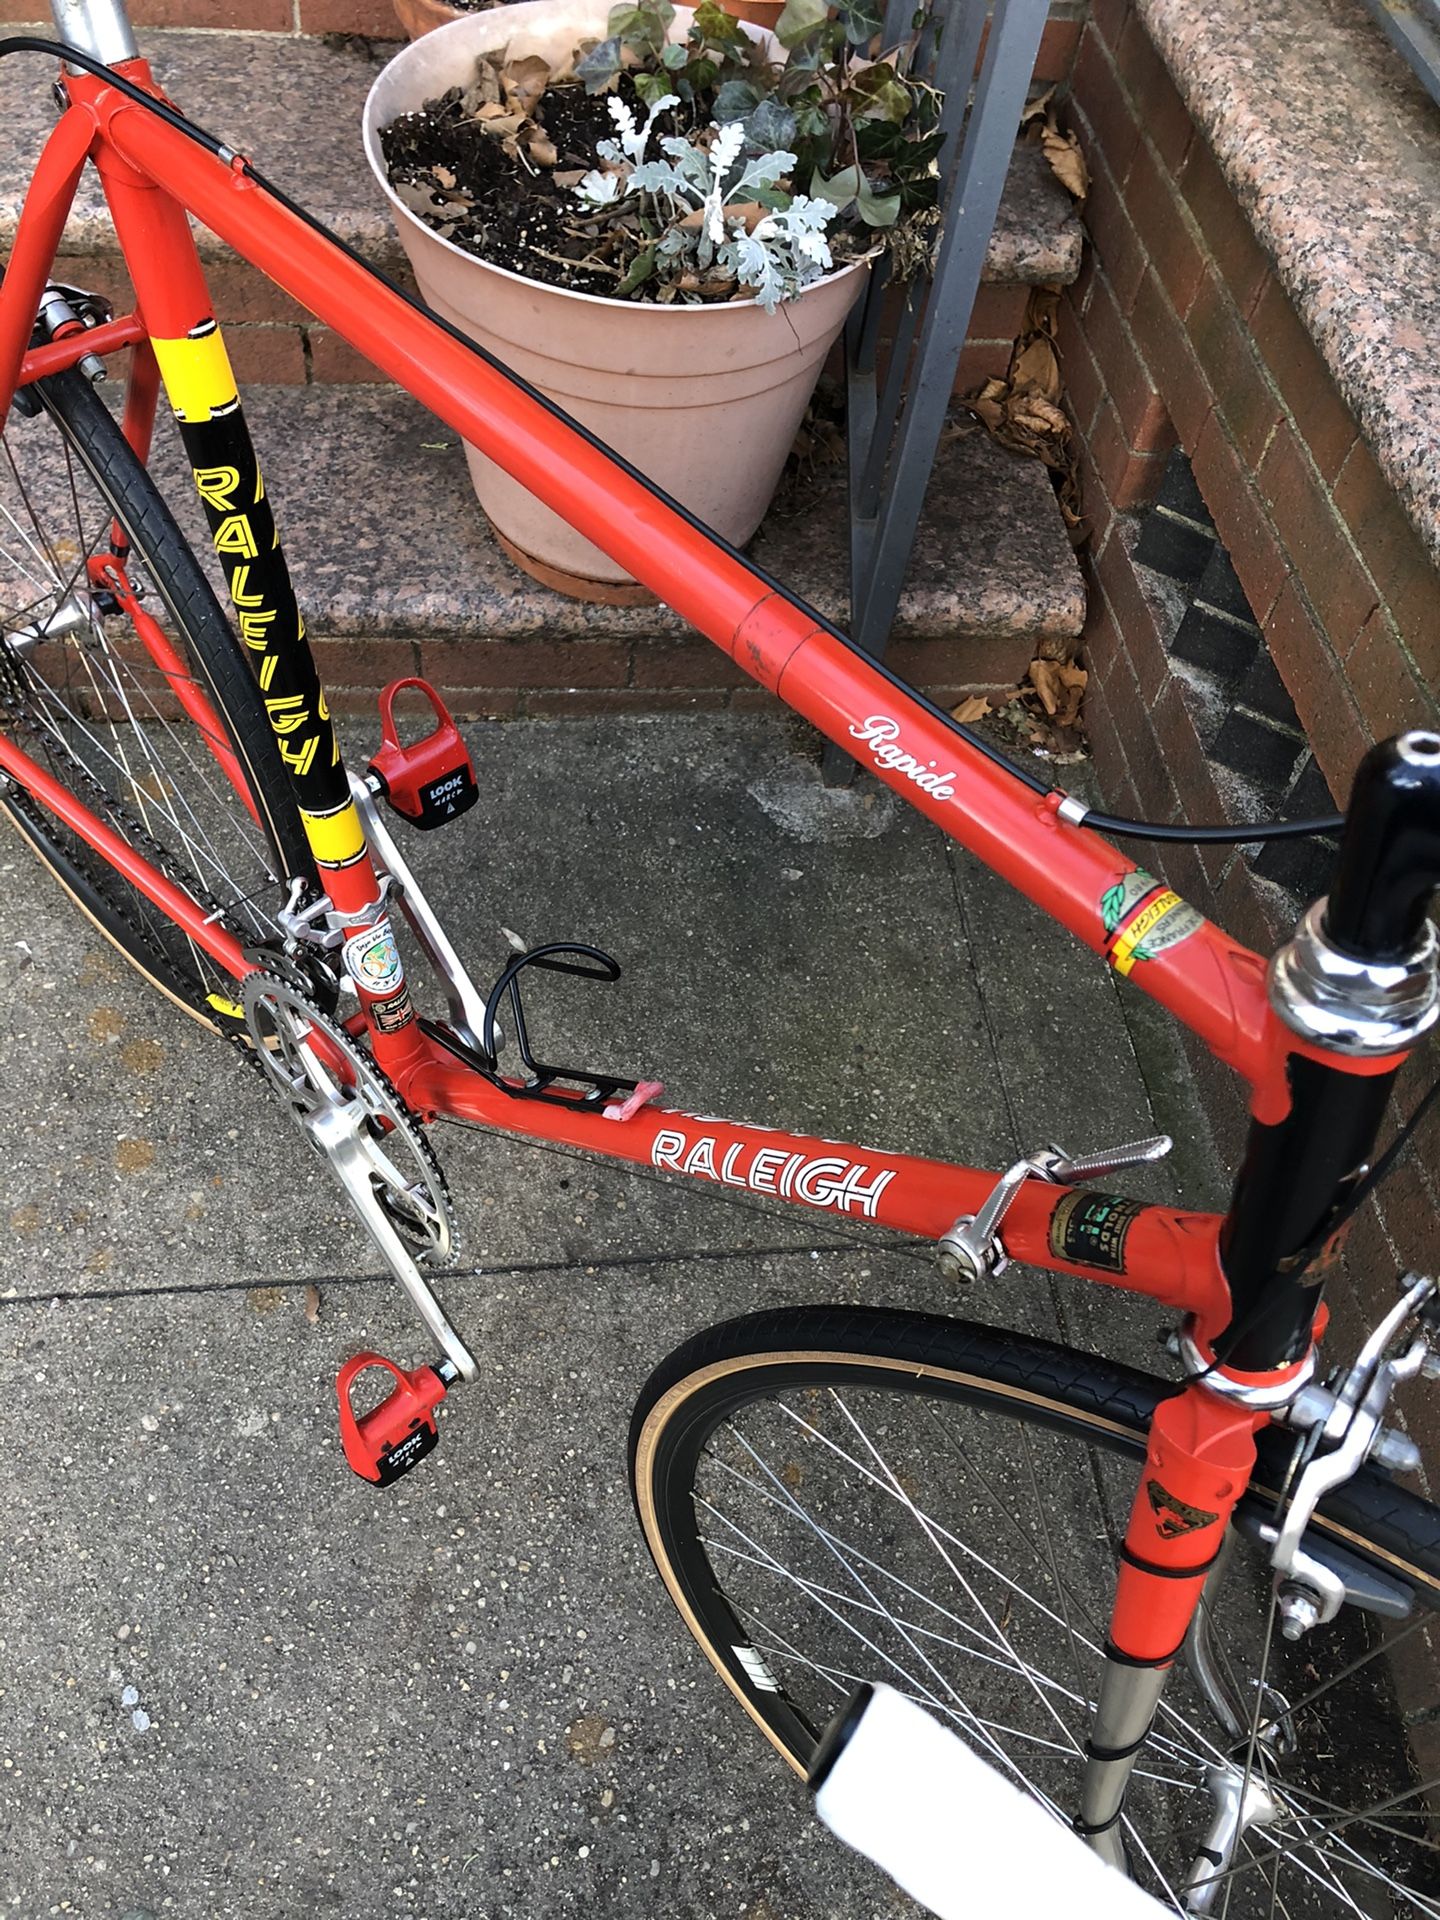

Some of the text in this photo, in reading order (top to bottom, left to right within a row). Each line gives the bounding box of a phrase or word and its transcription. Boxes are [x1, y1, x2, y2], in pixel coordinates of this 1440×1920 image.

[193, 466, 320, 776] RALEIGH
[430, 775, 463, 799] LOOK
[848, 714, 957, 800] Rapide
[651, 1129, 898, 1218] RALEIGH
[388, 1433, 422, 1464] LOOK
